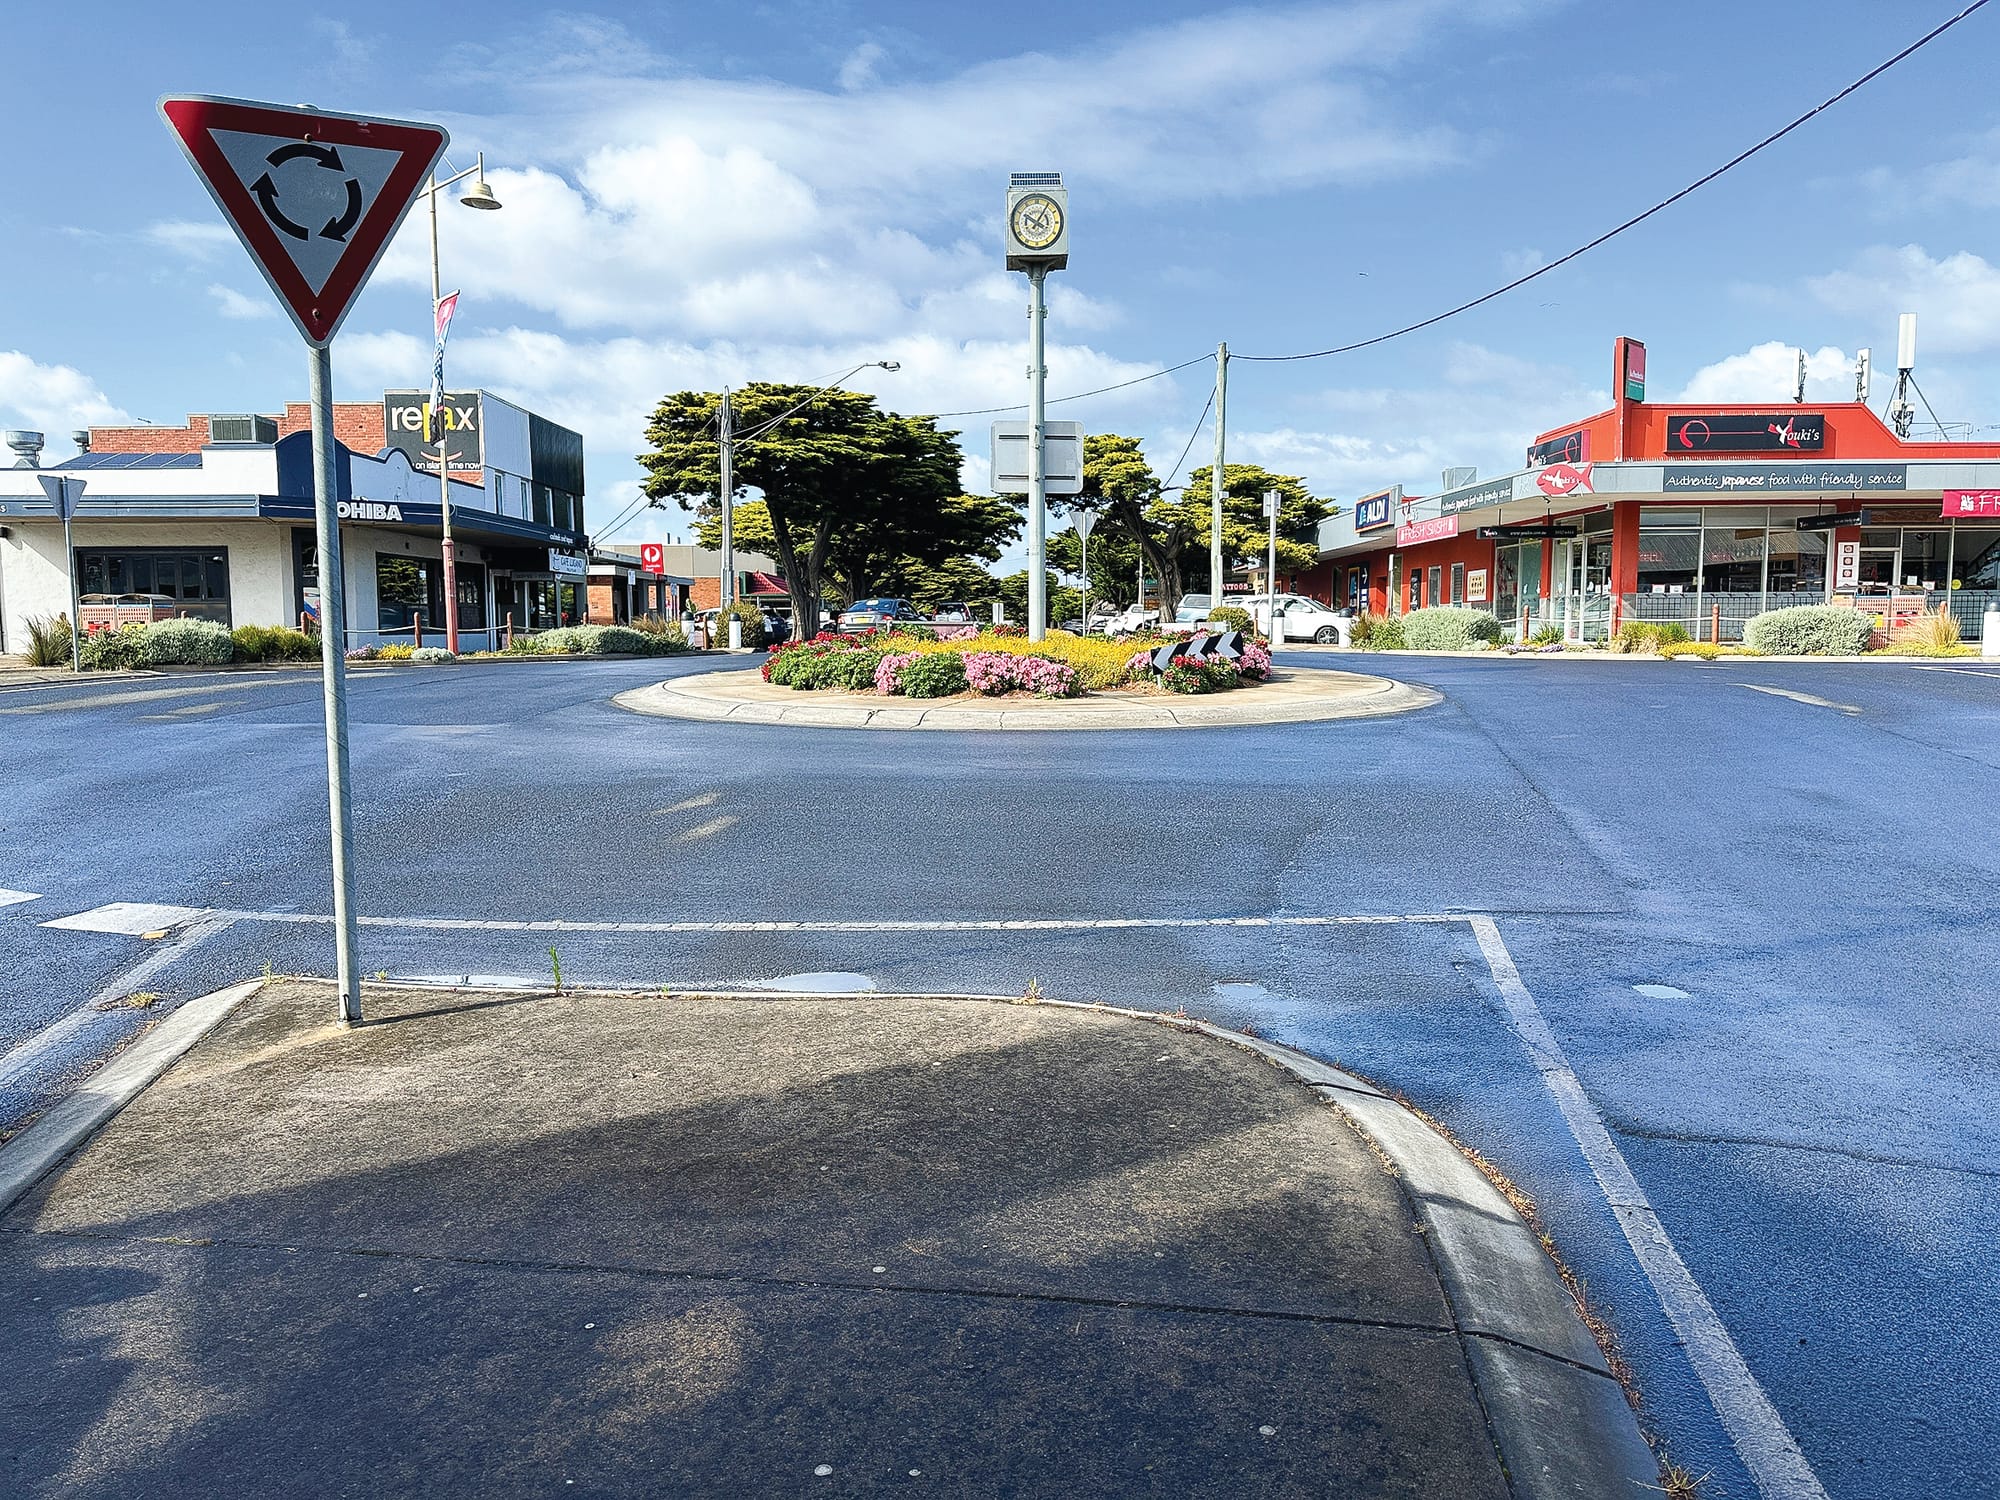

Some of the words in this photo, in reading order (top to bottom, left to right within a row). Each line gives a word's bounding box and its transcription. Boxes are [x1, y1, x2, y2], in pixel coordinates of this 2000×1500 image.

[1775, 420, 1820, 446] Youki's
[415, 462, 426, 470] on
[426, 460, 441, 470] islan
[448, 460, 464, 470] time
[465, 462, 481, 470] now
[1665, 473, 1718, 489] Authentic
[1768, 473, 1790, 489] food
[1793, 472, 1817, 485] with
[1820, 472, 1863, 489] friendly
[1868, 472, 1903, 484] service
[336, 501, 403, 521] OHIBA
[1366, 499, 1386, 524] ALDI
[1221, 583, 1249, 591] ATTOOS
